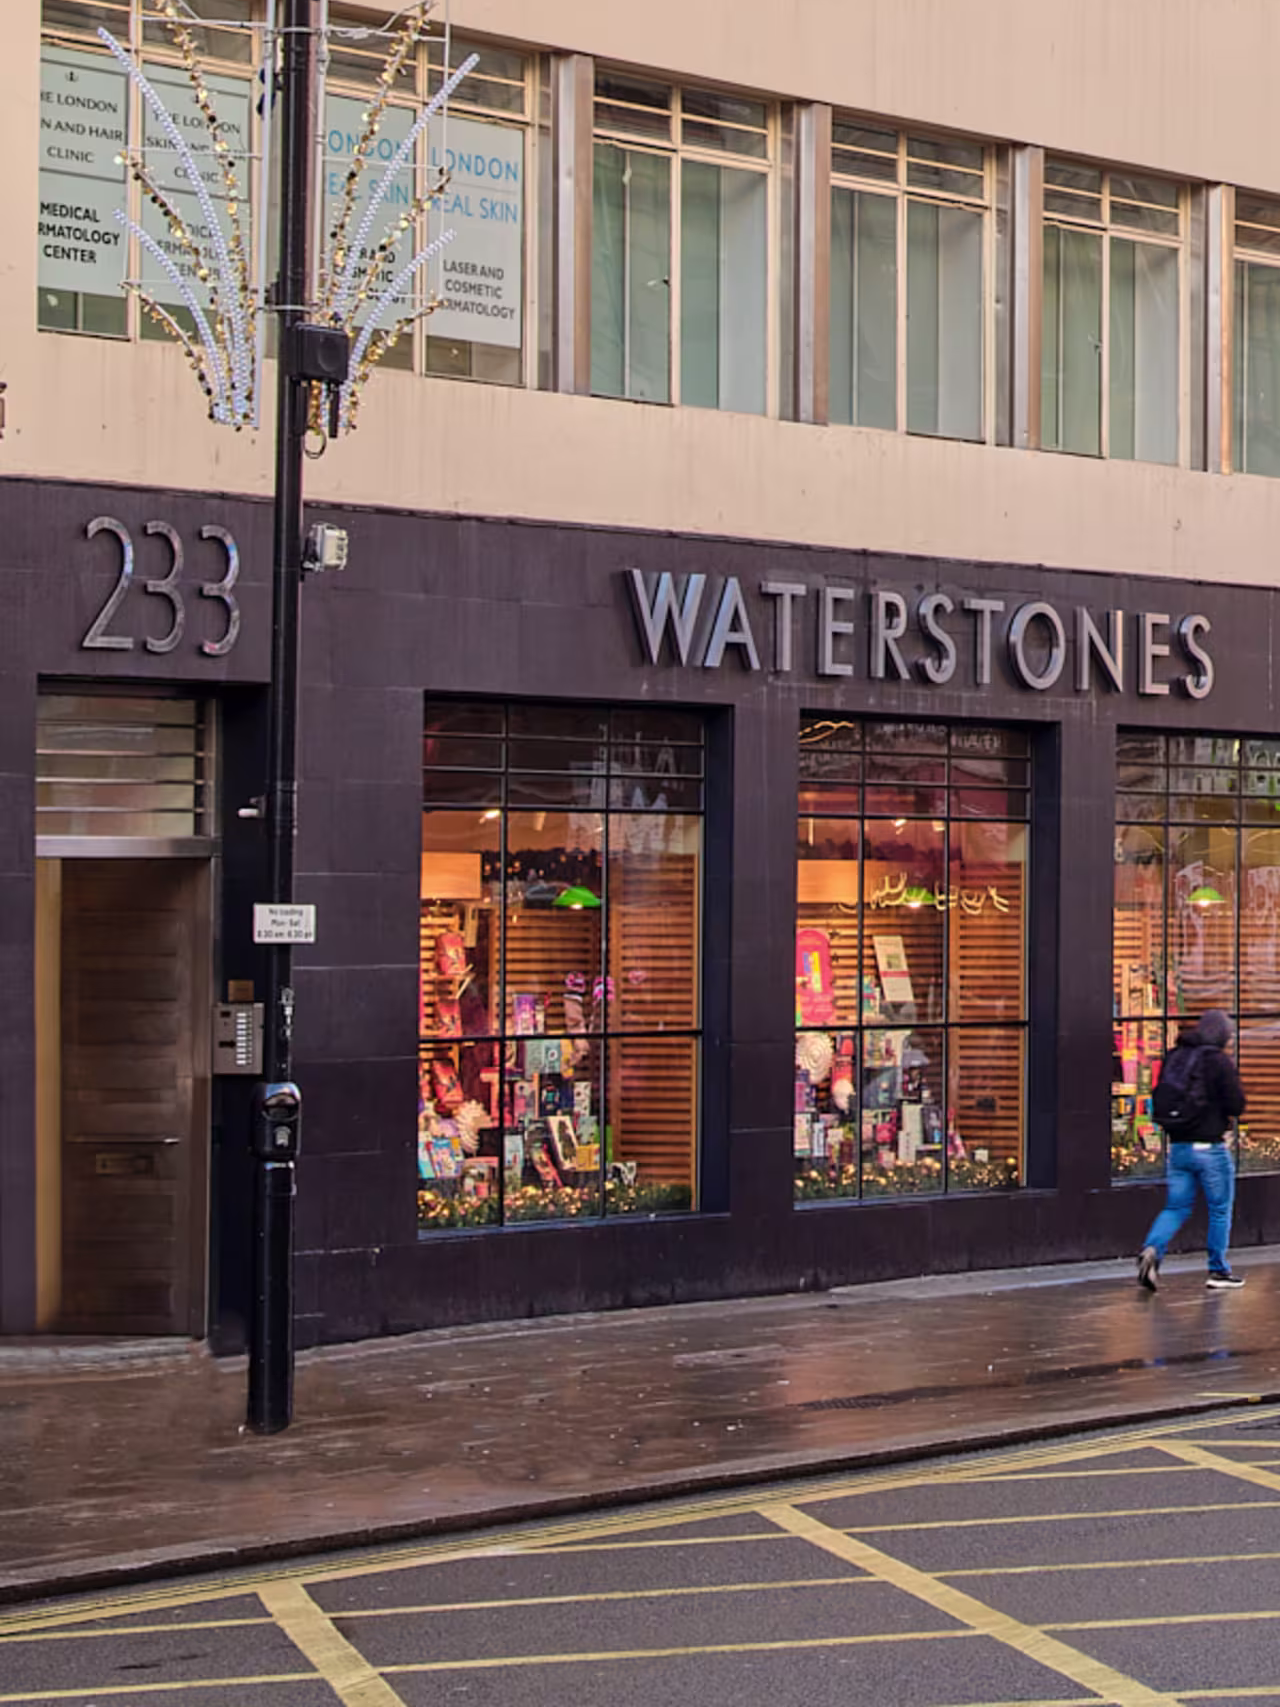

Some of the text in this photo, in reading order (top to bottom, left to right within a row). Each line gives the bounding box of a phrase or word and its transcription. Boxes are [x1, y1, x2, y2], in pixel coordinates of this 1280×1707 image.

[56, 93, 118, 114] LONDON
[48, 120, 86, 138] AND
[88, 124, 123, 143] HAIR
[46, 146, 95, 164] CLINIC
[432, 146, 519, 182] LONDON
[40, 202, 101, 224] MEDICAL
[479, 199, 518, 224] SKIN
[43, 245, 97, 265] CENTER
[443, 259, 505, 280] LASER AND
[445, 279, 503, 300] COSMETIC
[82, 515, 242, 658] 233
[624, 567, 1217, 699] WATERSTONES
